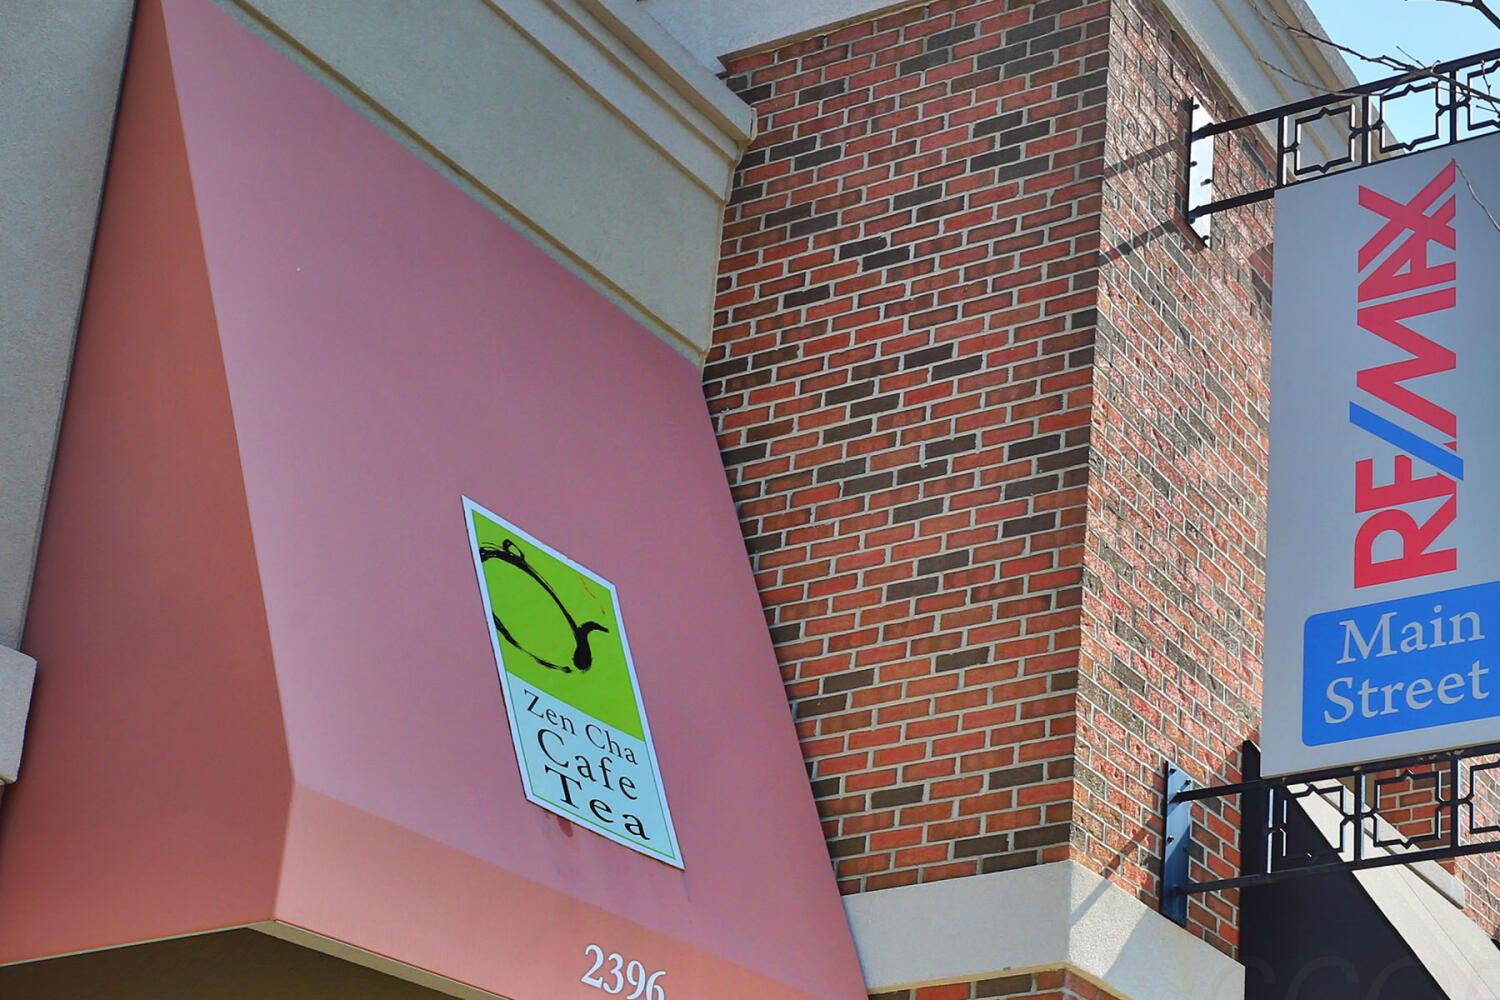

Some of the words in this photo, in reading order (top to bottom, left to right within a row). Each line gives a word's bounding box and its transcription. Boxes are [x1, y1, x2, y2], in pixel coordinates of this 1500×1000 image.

[1349, 158, 1464, 589] RE/MAX
[1336, 604, 1486, 665] Main
[524, 688, 577, 736] Zen
[585, 723, 639, 765] Cha
[1323, 662, 1490, 725] Street
[537, 728, 638, 801] Cafe
[544, 764, 651, 841] Tea
